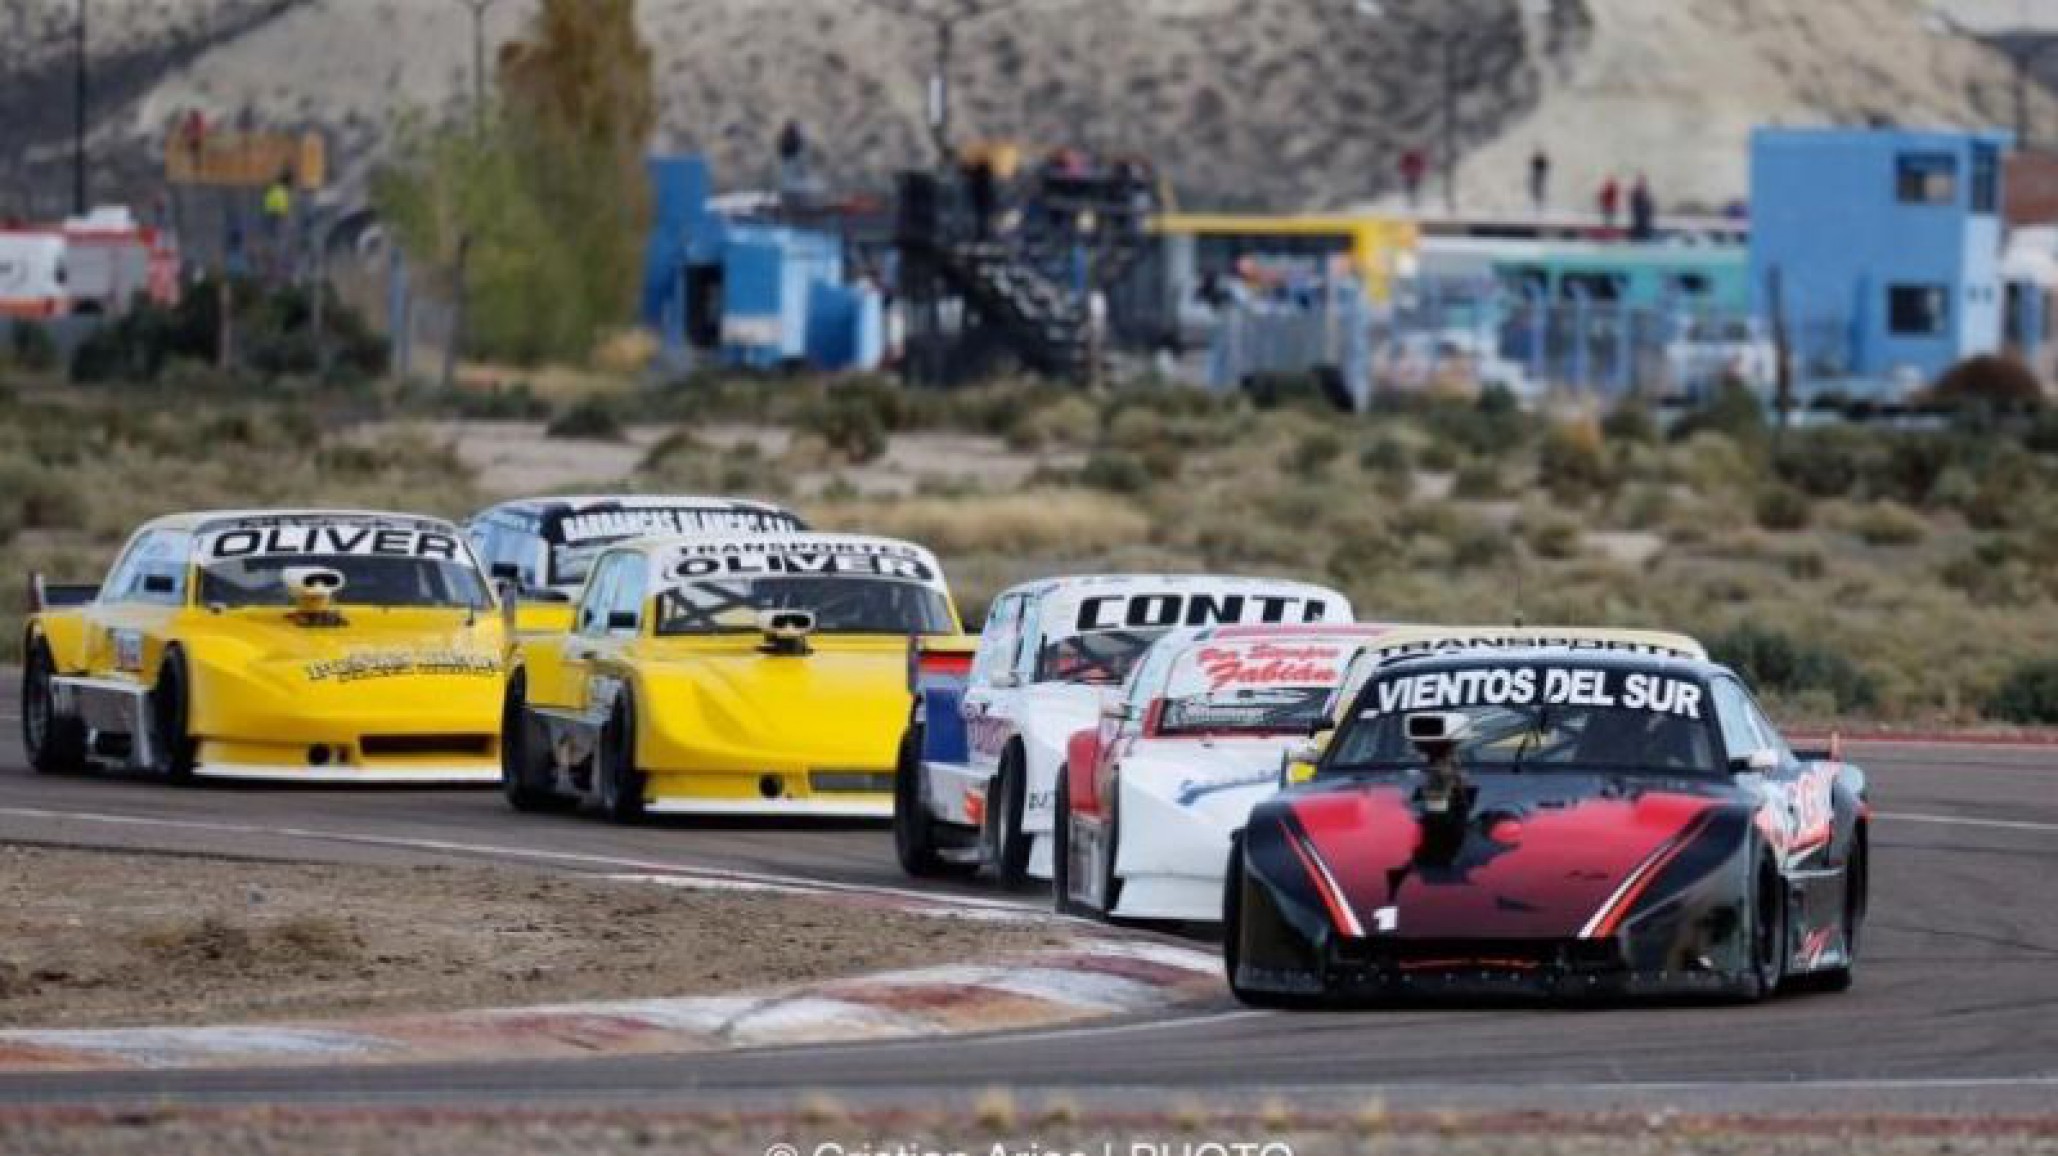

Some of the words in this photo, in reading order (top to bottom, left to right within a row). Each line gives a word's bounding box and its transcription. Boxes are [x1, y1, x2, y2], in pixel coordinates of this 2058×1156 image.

[213, 529, 457, 558] OLIVER
[676, 553, 933, 581] OLIVER
[1378, 668, 1536, 712] VIENTOS
[1545, 668, 1614, 706] DEL
[1623, 674, 1700, 719] SUR
[1373, 906, 1397, 930] 1
